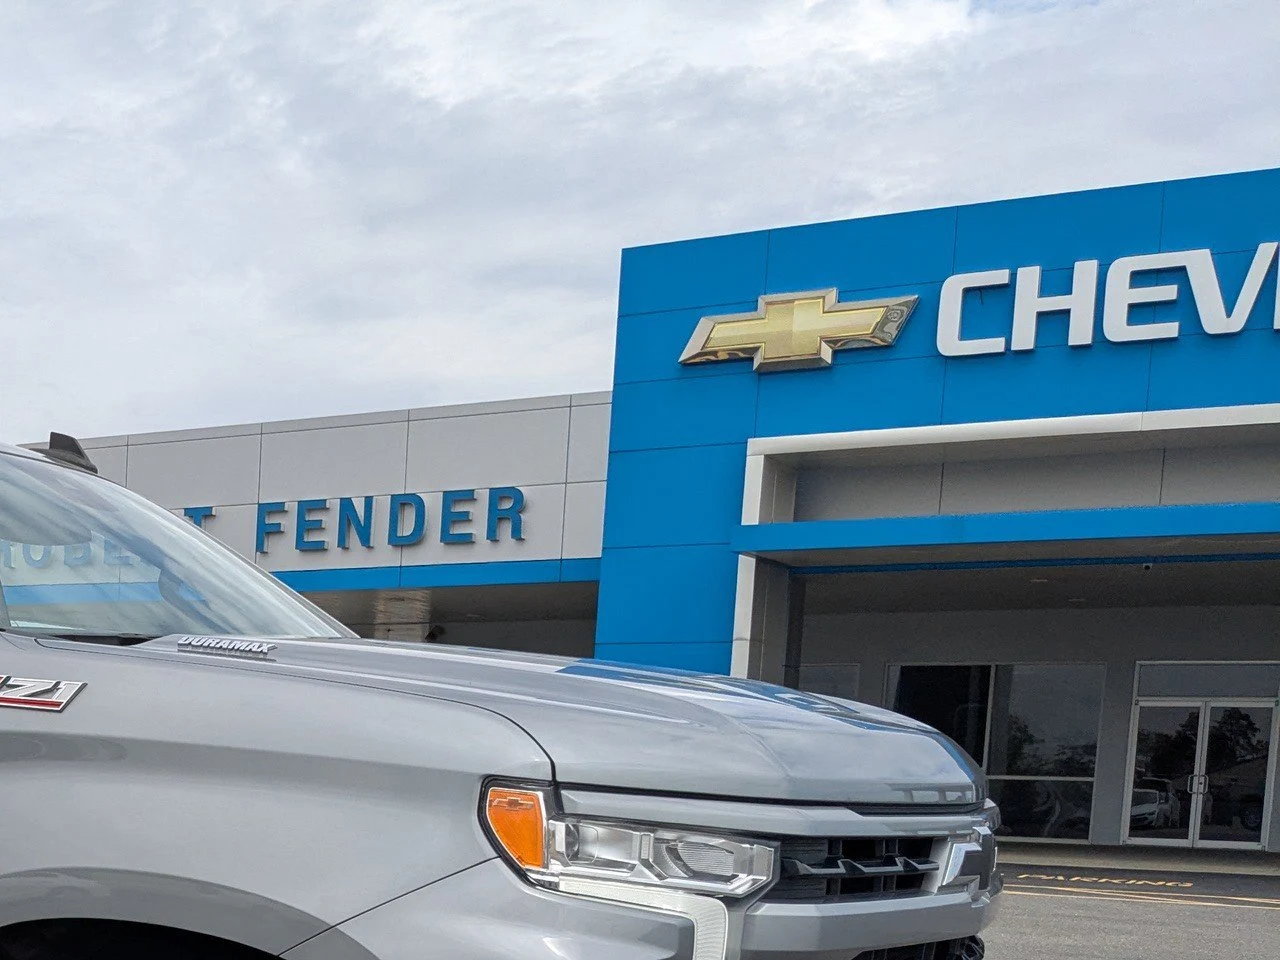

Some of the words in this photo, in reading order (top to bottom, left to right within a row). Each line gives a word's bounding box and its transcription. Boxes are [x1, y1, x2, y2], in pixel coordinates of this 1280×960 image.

[936, 241, 1280, 357] CHEV
[257, 487, 526, 554] FENDER
[178, 636, 277, 654] DURAMAX
